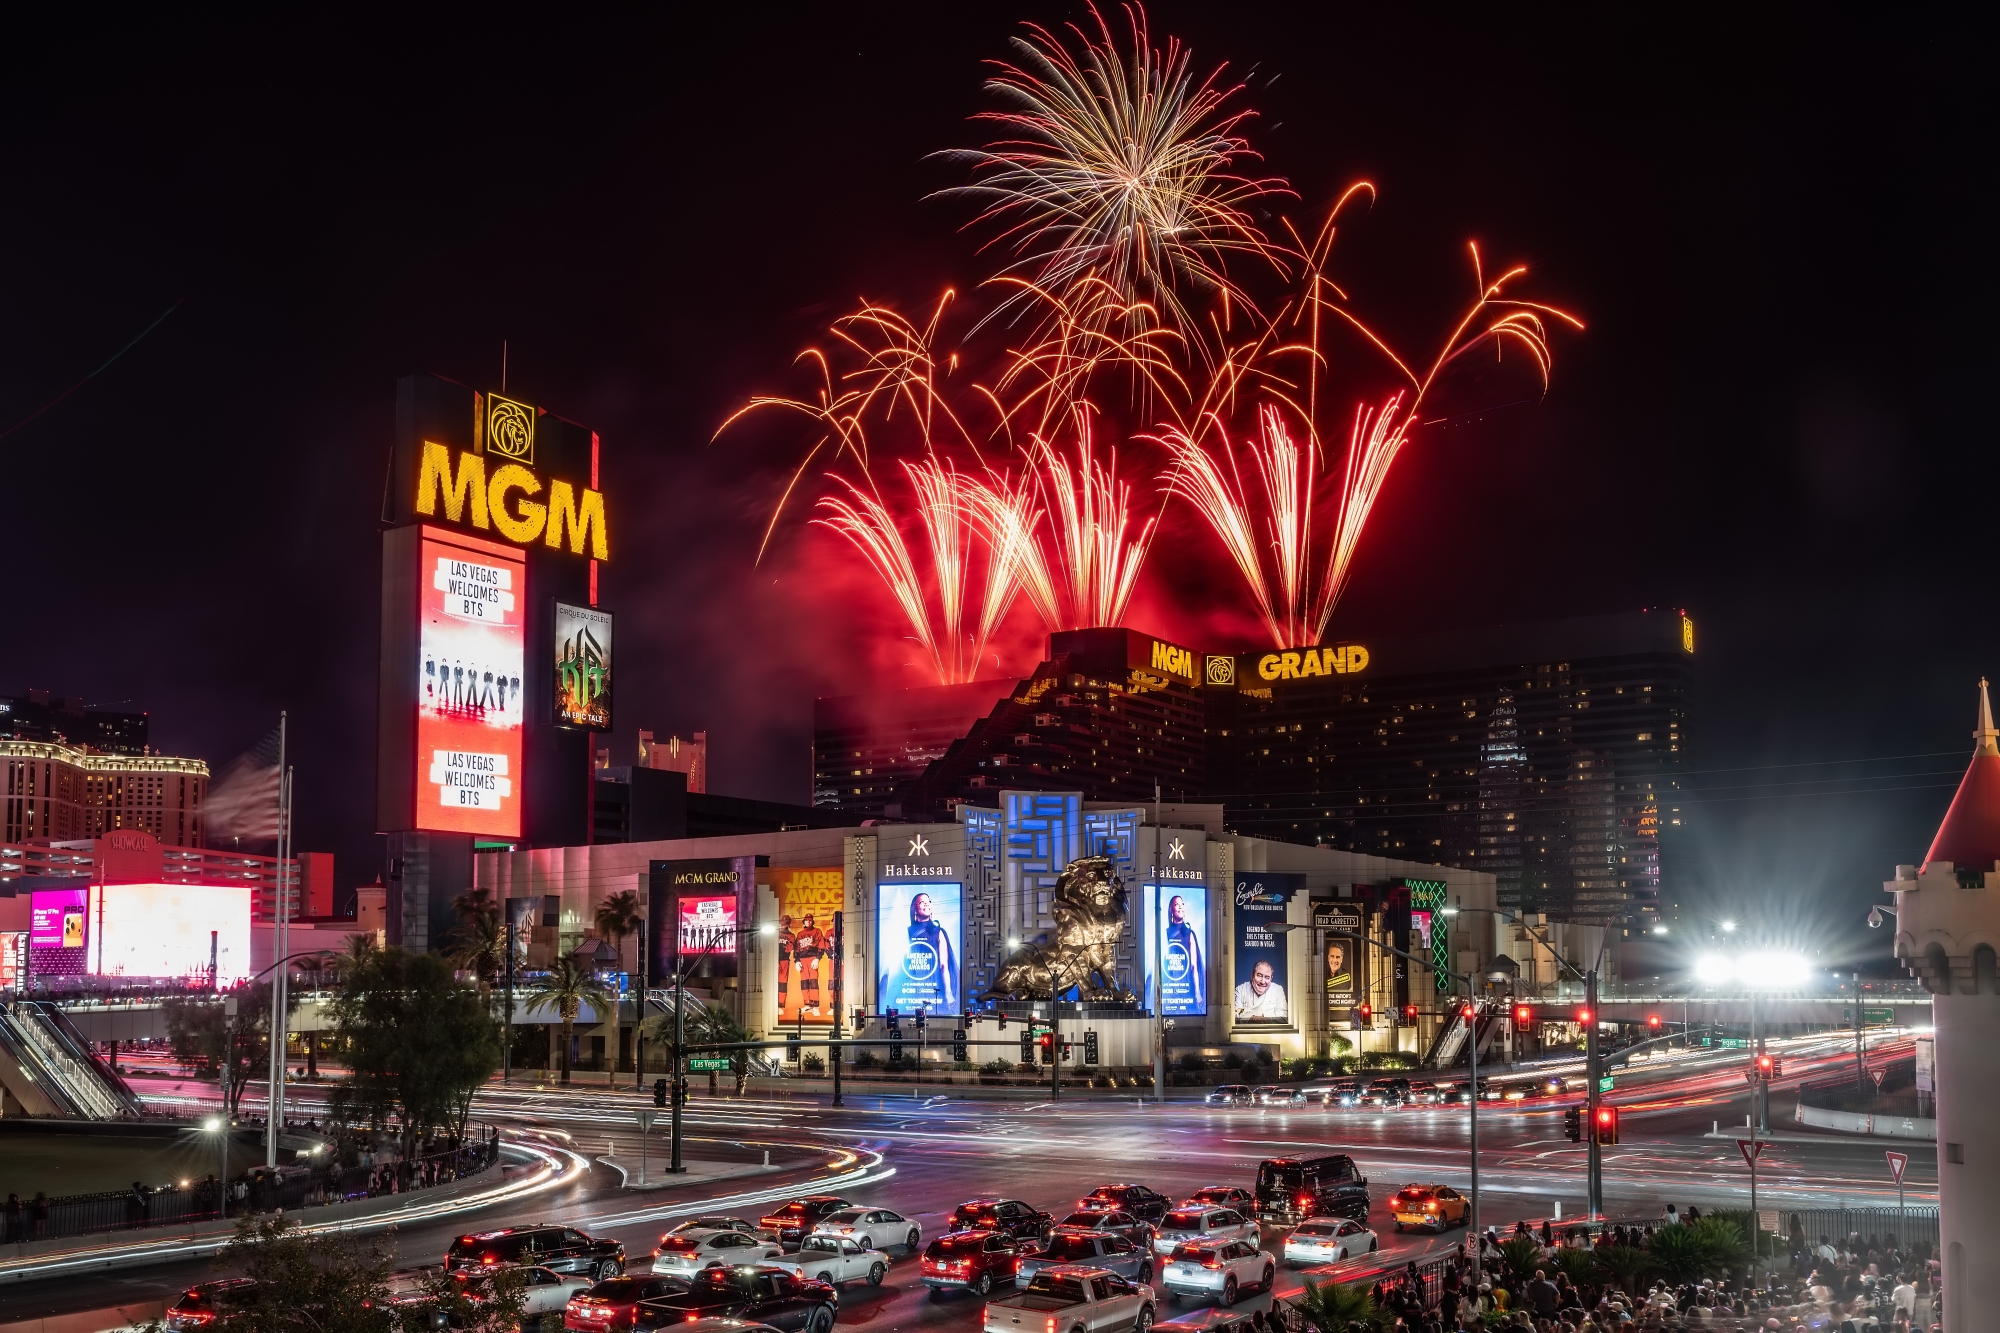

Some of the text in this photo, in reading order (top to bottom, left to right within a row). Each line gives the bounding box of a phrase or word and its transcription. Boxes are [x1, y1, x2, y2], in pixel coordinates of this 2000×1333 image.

[416, 440, 609, 561] MGM
[451, 561, 498, 585] LAS VEGAS
[449, 579, 499, 603] WELCOMES
[464, 600, 483, 617] BTS
[559, 607, 609, 624] CIRQUE DU SOLEIL
[1152, 640, 1370, 681] MGM GRAND
[561, 711, 603, 723] AN EPIC TALE
[447, 752, 494, 772] LAS VEGAS
[445, 770, 495, 790] WELCOMES
[460, 790, 480, 806] BTS
[111, 835, 149, 851] SHOWCASE
[675, 871, 738, 884] MGM GRAND
[885, 864, 953, 877] Hakkasan
[785, 872, 843, 889] JABB
[785, 888, 843, 904] AWOC
[64, 906, 84, 914] PRO
[1317, 917, 1356, 925] BRAD GARRETT'S
[694, 1060, 704, 1068] Las
[704, 1060, 721, 1070] Vegas
